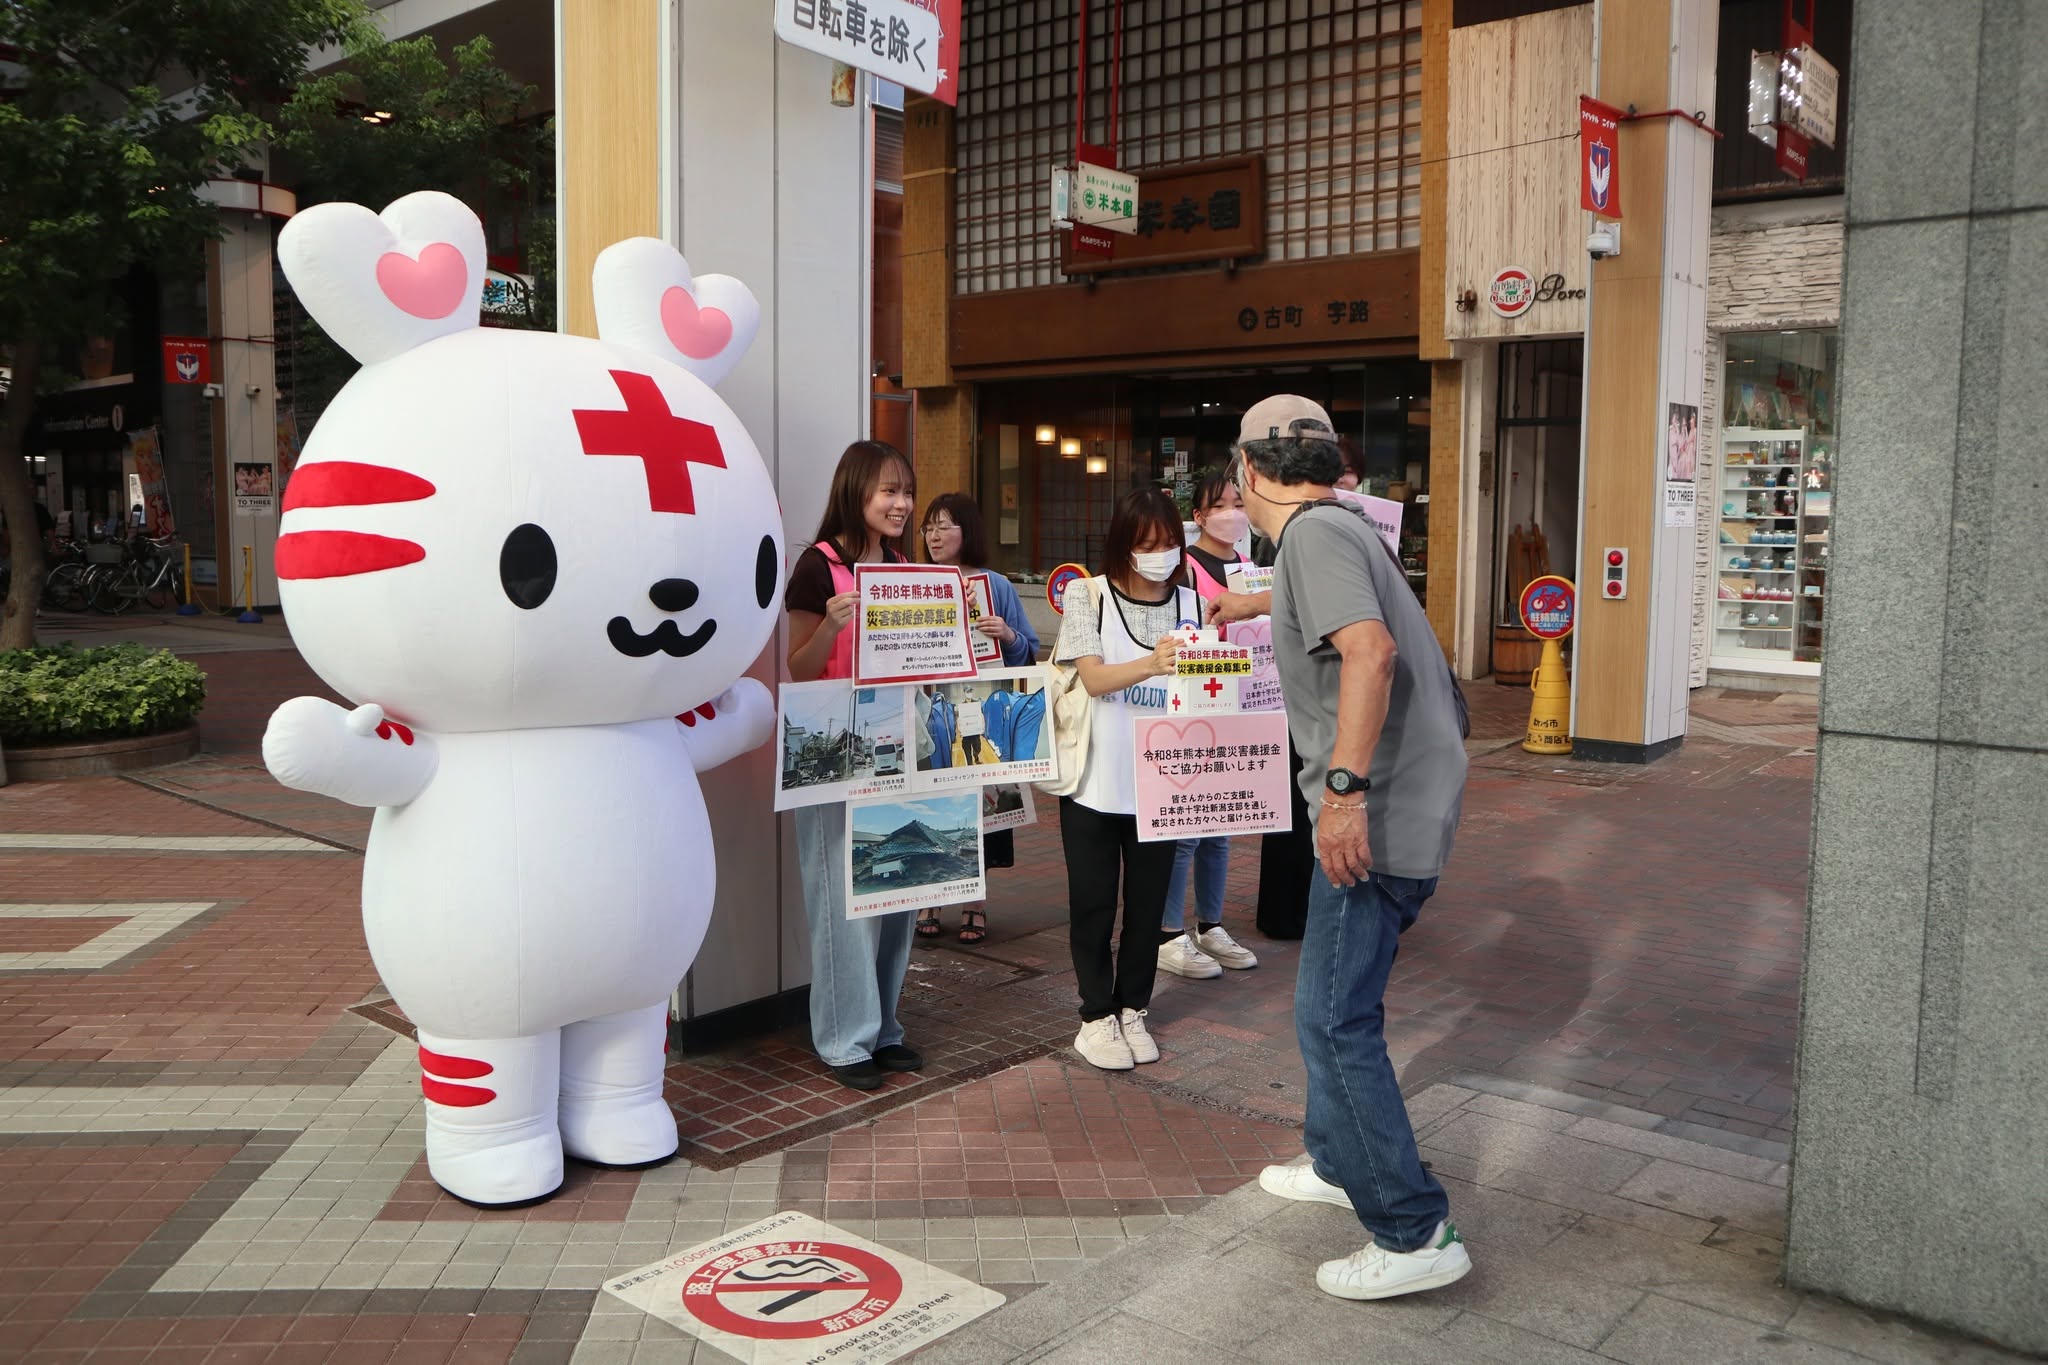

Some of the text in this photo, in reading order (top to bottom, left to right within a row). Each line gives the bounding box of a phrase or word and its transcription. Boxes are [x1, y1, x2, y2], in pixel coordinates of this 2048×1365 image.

[793, 0, 927, 73] 自転車を除く
[1098, 192, 1134, 218] 米本園
[1264, 304, 1304, 329] 古町
[1667, 490, 1694, 502] TO THREE
[869, 584, 954, 600] 令和8年熊本地震
[867, 609, 957, 628] 災害義援金募集中
[1178, 648, 1249, 661] 令和8年熊本地震
[1177, 662, 1251, 675] 災害義援金募集中
[1143, 743, 1281, 762] 令和8年熊本地震災害義援金
[1159, 759, 1267, 776] にご協力お願いします
[1171, 790, 1255, 804] 皆さんからのご支援は
[1159, 800, 1267, 817] 日本赤十字社新潟支部を通じ
[686, 1241, 821, 1297] 路上喫煙禁止
[821, 1297, 890, 1333] 新潟市
[825, 1328, 879, 1357] Smoking
[878, 1321, 895, 1332] on
[892, 1308, 920, 1324] This
[918, 1292, 955, 1312] Street
